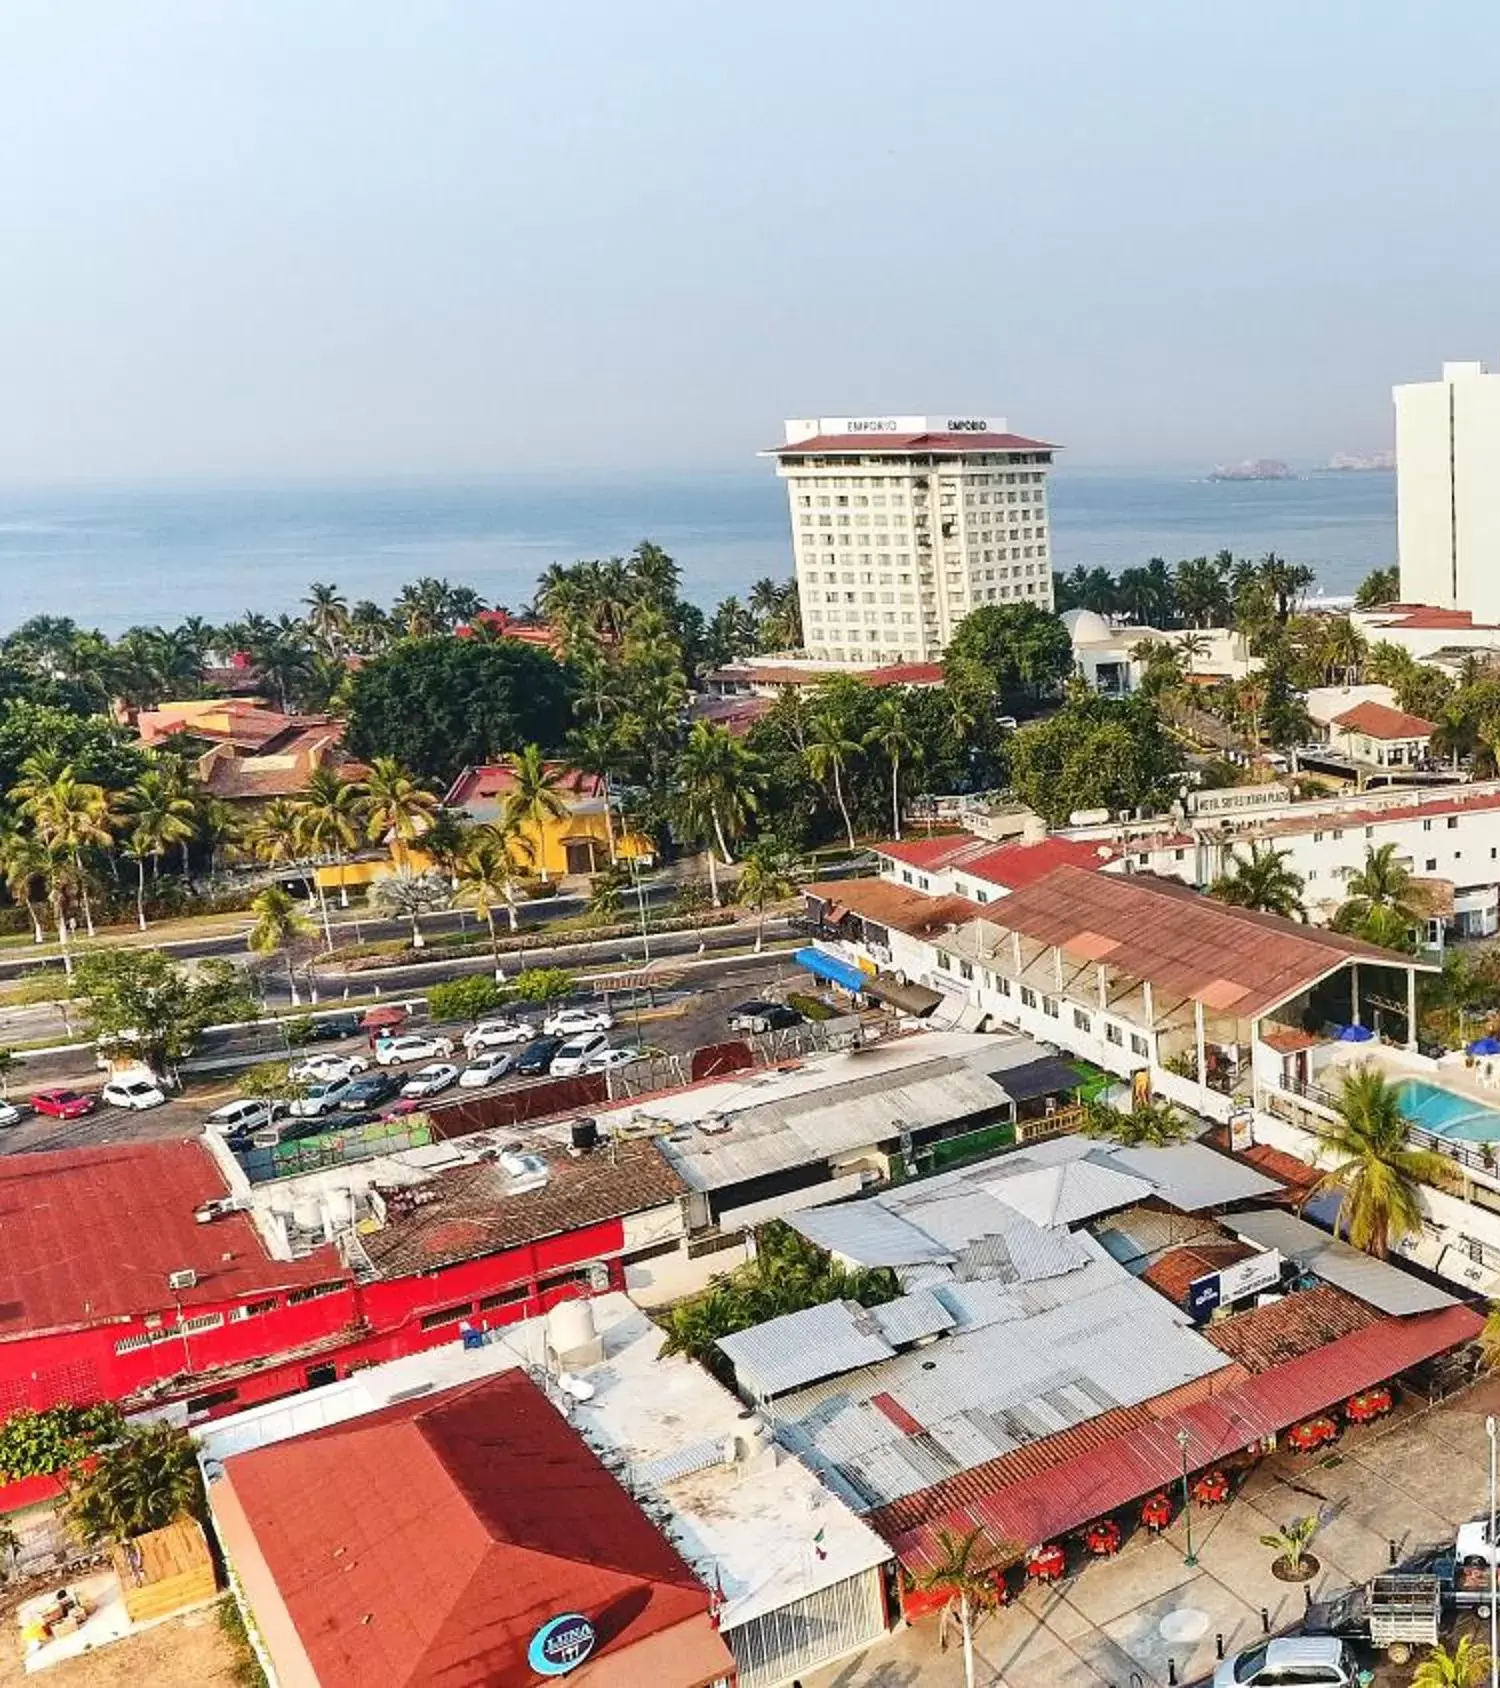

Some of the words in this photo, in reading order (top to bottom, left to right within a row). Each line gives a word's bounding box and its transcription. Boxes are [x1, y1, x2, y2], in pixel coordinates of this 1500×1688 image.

[847, 419, 897, 432] EMPORIO
[947, 419, 987, 431] EMPORIO
[546, 1623, 592, 1651] LUNA
